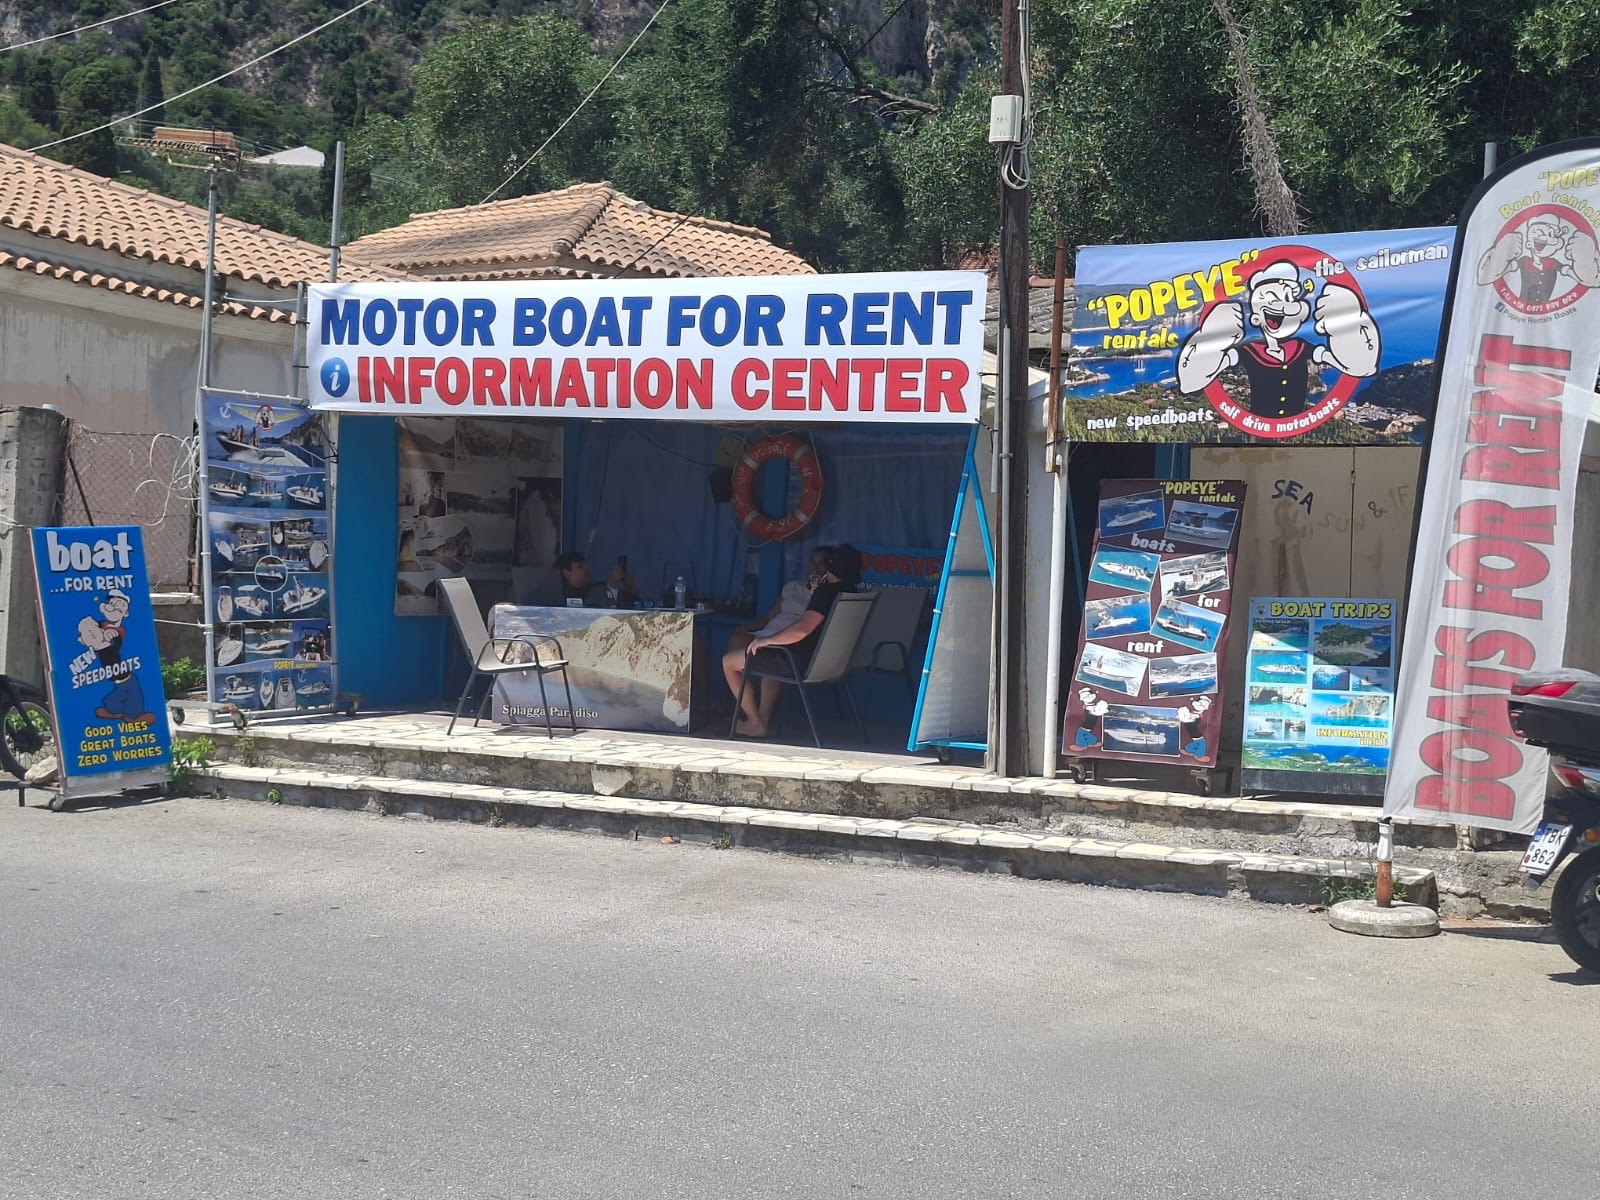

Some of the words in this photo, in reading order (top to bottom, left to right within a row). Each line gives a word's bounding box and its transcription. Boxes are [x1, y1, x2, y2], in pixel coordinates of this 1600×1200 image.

[1499, 191, 1542, 219] Boat
[1314, 257, 1345, 278] the
[1356, 245, 1448, 271] sailorman
[320, 297, 496, 347] MOTOR
[512, 296, 653, 348] BOAT
[666, 294, 786, 347] FOR
[803, 290, 973, 347] RENT
[1102, 327, 1180, 349] rentals
[357, 357, 713, 411] INFORMATION
[731, 357, 970, 413] CENTER
[1087, 417, 1117, 430] new
[1125, 408, 1214, 431] speedboats
[1219, 401, 1240, 419] self
[1242, 416, 1270, 432] drive
[1276, 397, 1340, 432] motorboats
[1460, 334, 1571, 490] RENT
[1199, 492, 1236, 503] rentals
[1271, 479, 1314, 515] SEA
[46, 530, 133, 572] boat
[1130, 532, 1176, 554] boats
[1442, 499, 1557, 620] FOR
[96, 574, 134, 591] RENT
[1197, 594, 1221, 609] for
[1270, 602, 1326, 618] BOAT
[1330, 602, 1392, 619] TRIPS
[1127, 639, 1164, 654] rent
[69, 646, 97, 675] NEW
[71, 656, 141, 689] SPEEDBOATS
[550, 707, 599, 719] Pardiso
[1413, 624, 1535, 821] BOATS
[85, 725, 113, 739] GOOD
[118, 721, 148, 735] VIBES
[80, 739, 115, 752] GREAT
[120, 734, 156, 748] BOATS
[77, 754, 108, 767] ZERO
[113, 746, 162, 763] WORRIES
[1531, 848, 1556, 866] 862
